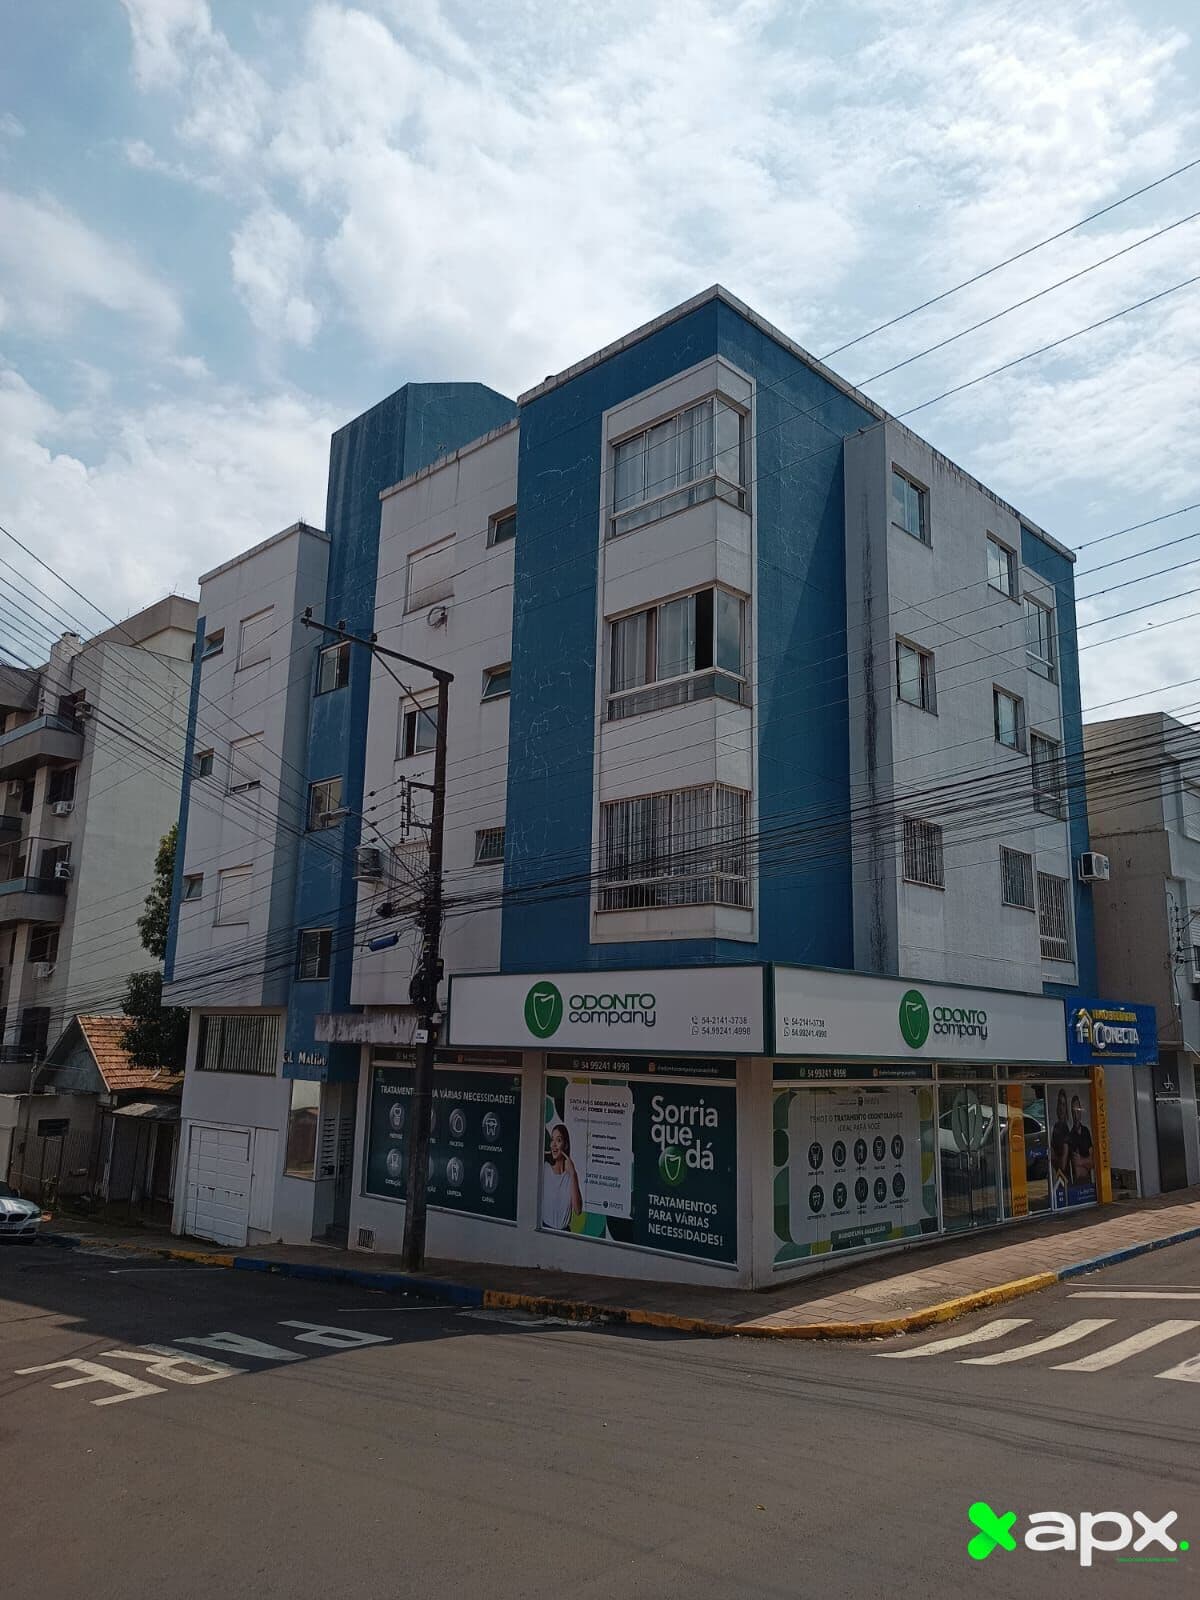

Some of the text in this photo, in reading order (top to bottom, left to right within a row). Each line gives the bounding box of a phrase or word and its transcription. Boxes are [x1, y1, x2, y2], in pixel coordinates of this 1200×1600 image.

[569, 994, 656, 1010] ODONTO
[568, 1009, 656, 1027] company
[932, 1006, 987, 1025] ODONTO
[932, 1022, 988, 1041] company
[1093, 1022, 1140, 1049] CONECTA
[438, 1087, 463, 1100] VÁRIAS
[463, 1091, 515, 1105] NECESSIDADES!
[651, 1095, 718, 1128] Sorria
[651, 1123, 693, 1150] que
[685, 1139, 714, 1170] dá
[648, 1194, 718, 1216] TRATAMENTOS
[648, 1208, 710, 1231] PARA VÁRIAS
[648, 1223, 723, 1247] NECESSIDADES!
[15, 1320, 393, 1406] PARE
